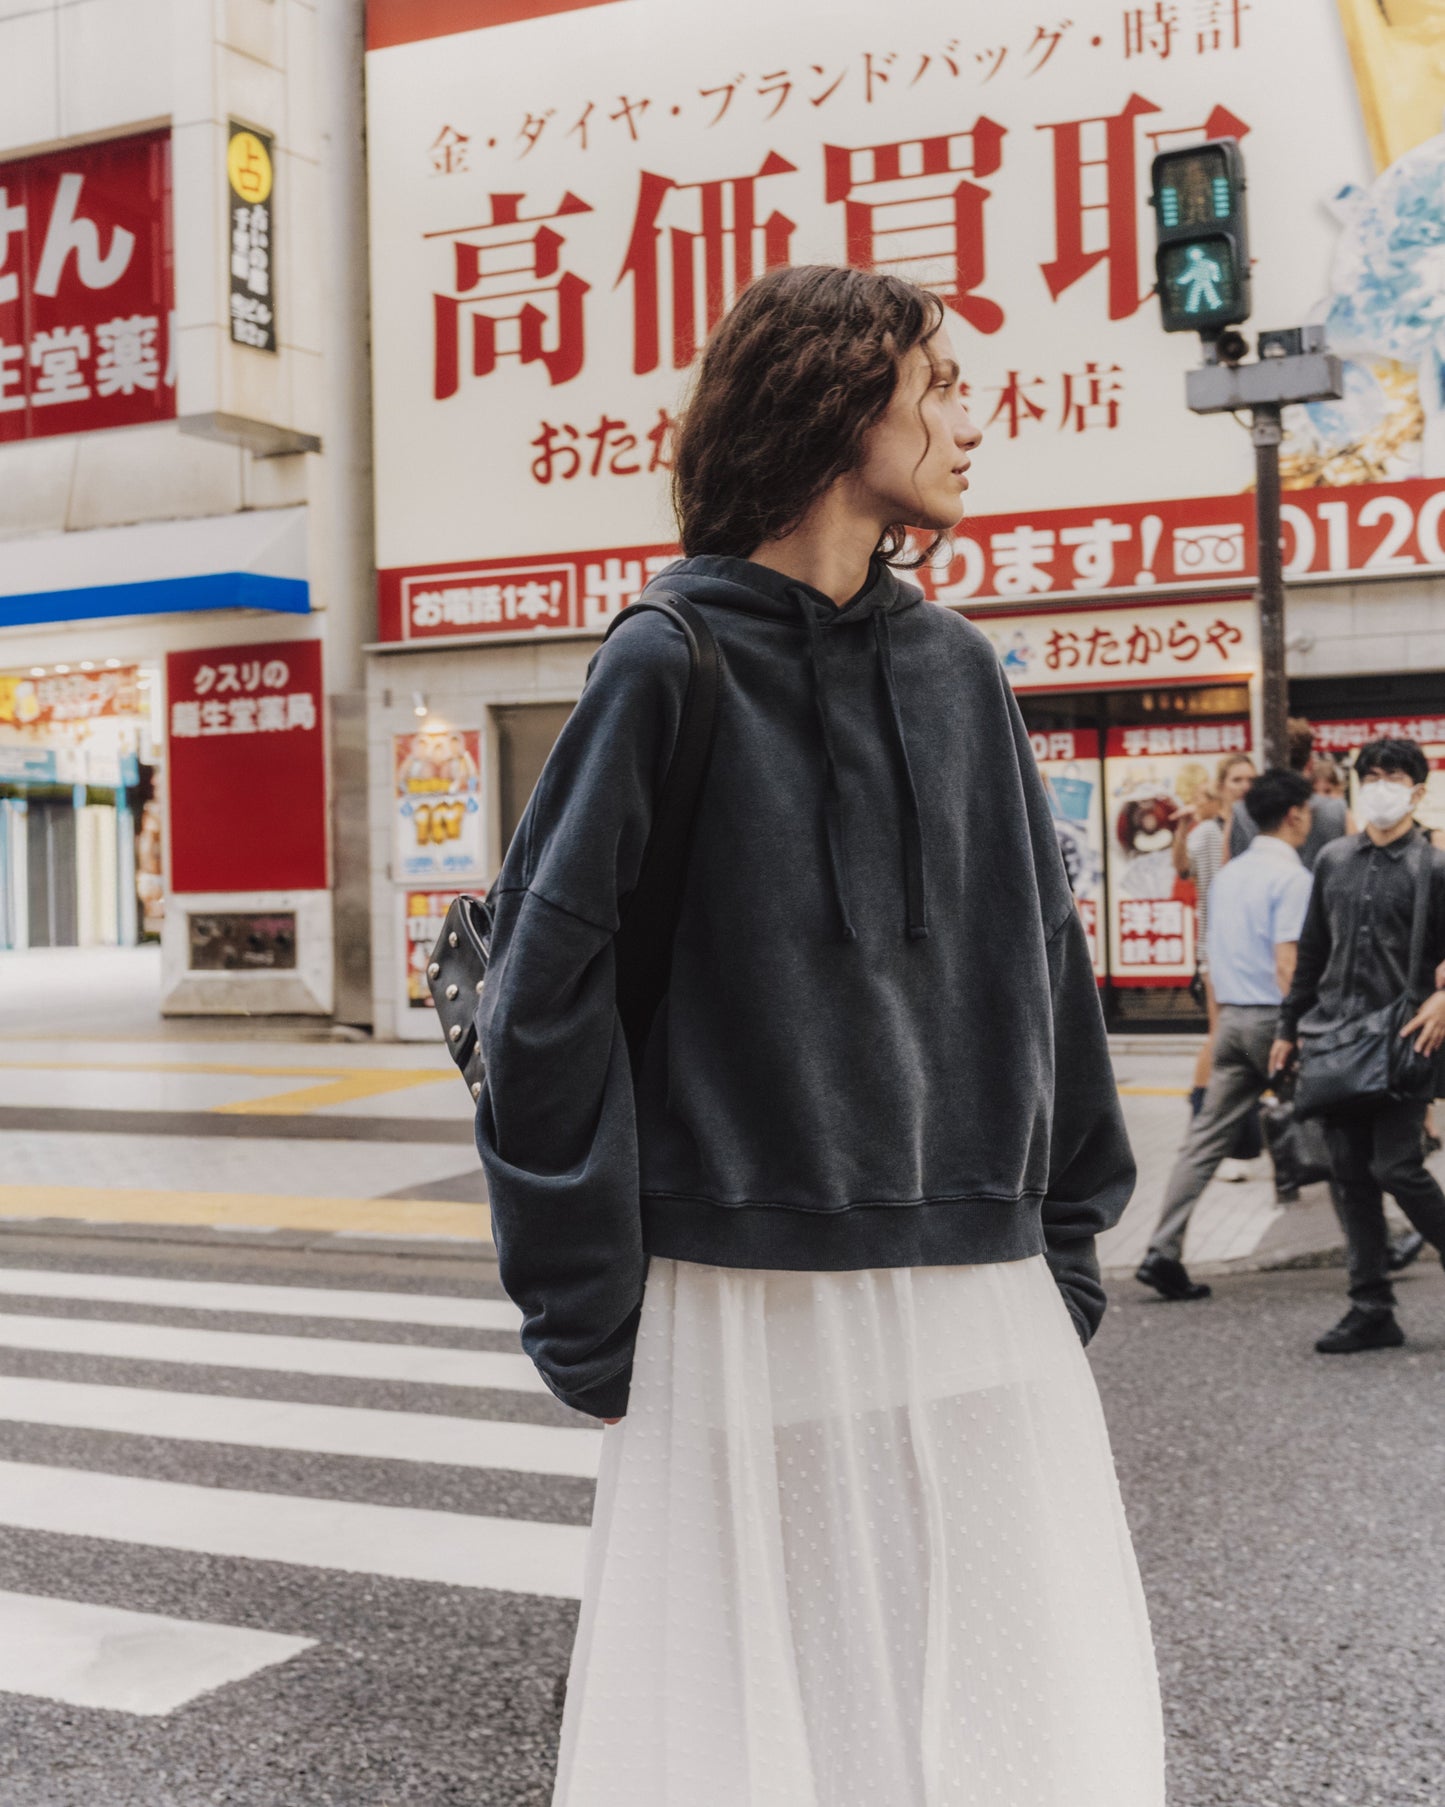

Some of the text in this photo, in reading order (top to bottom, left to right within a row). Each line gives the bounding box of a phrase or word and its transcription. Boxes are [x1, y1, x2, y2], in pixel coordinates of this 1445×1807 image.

[422, 92, 1257, 402] 高価買取
[0, 314, 177, 412] 堂薬
[959, 362, 1124, 440] 本店
[583, 554, 686, 632] 出
[194, 660, 290, 695] クスリの
[1043, 618, 1243, 671] おたからや
